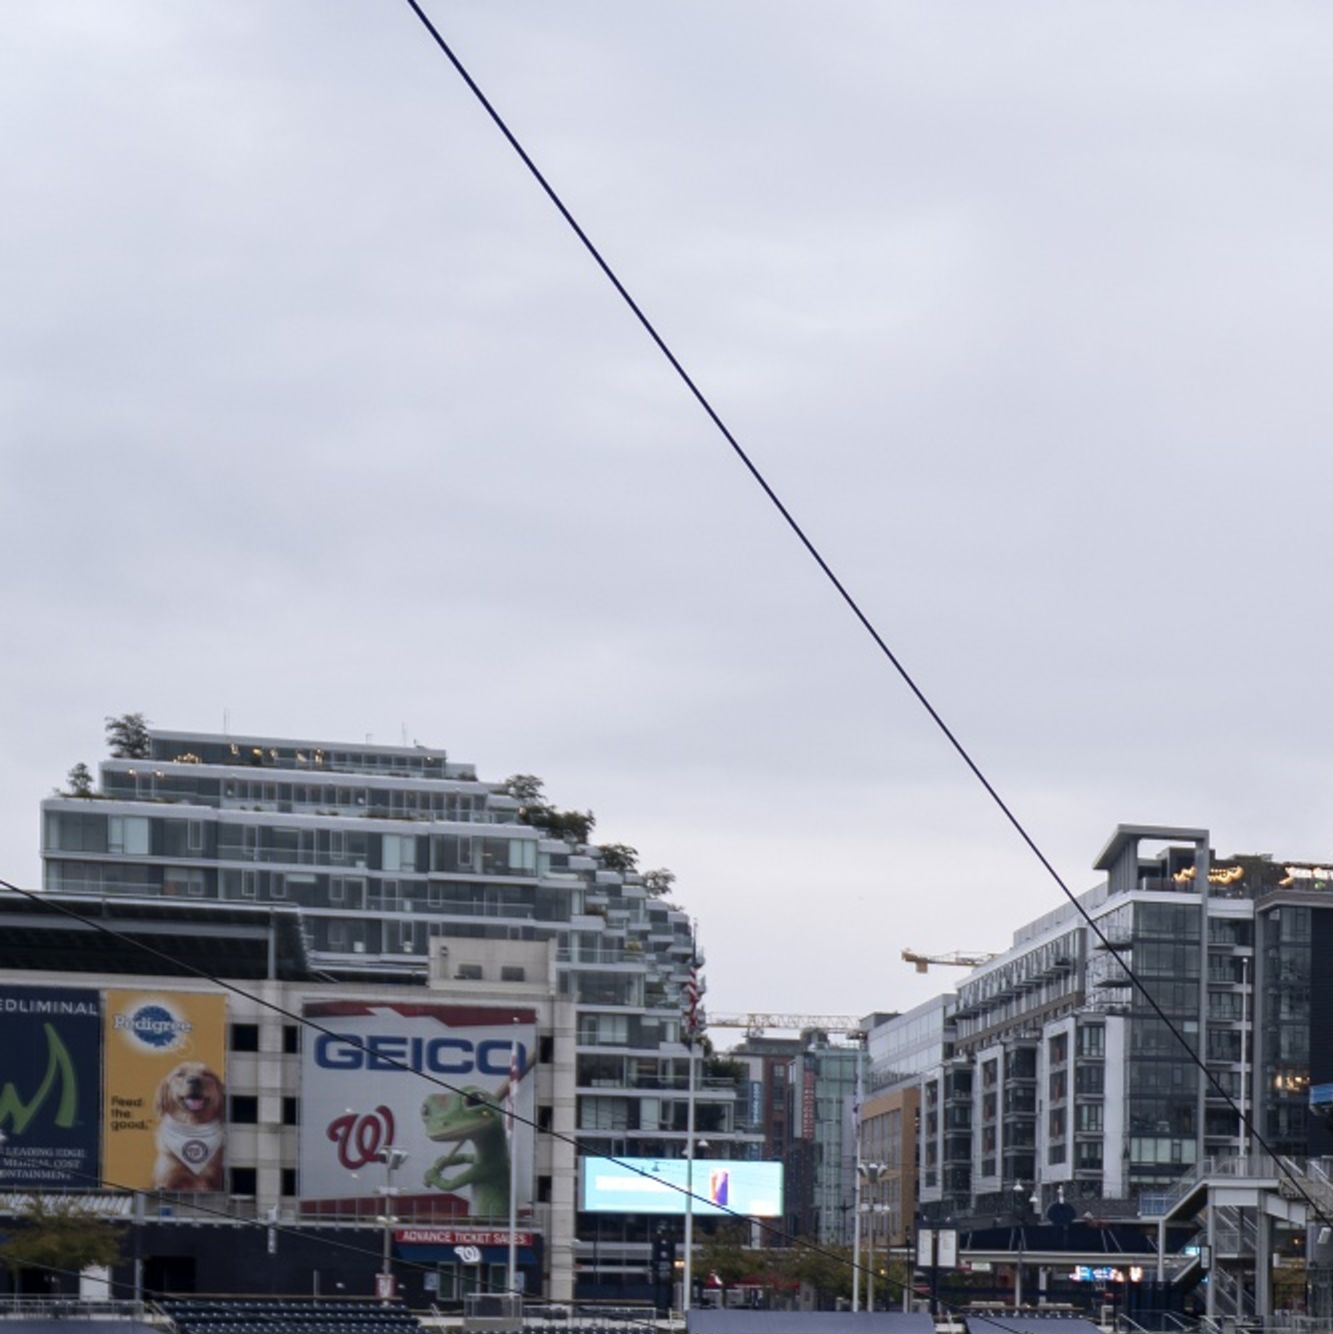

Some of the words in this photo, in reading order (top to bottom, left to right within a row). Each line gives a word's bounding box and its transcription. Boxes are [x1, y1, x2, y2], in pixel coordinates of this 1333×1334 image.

[0, 998, 98, 1016] DLIMINAL
[113, 1015, 192, 1035] Pedigree
[314, 1033, 527, 1076] GEICO
[402, 1231, 451, 1243] ADVANCE
[454, 1232, 491, 1244] TICKET
